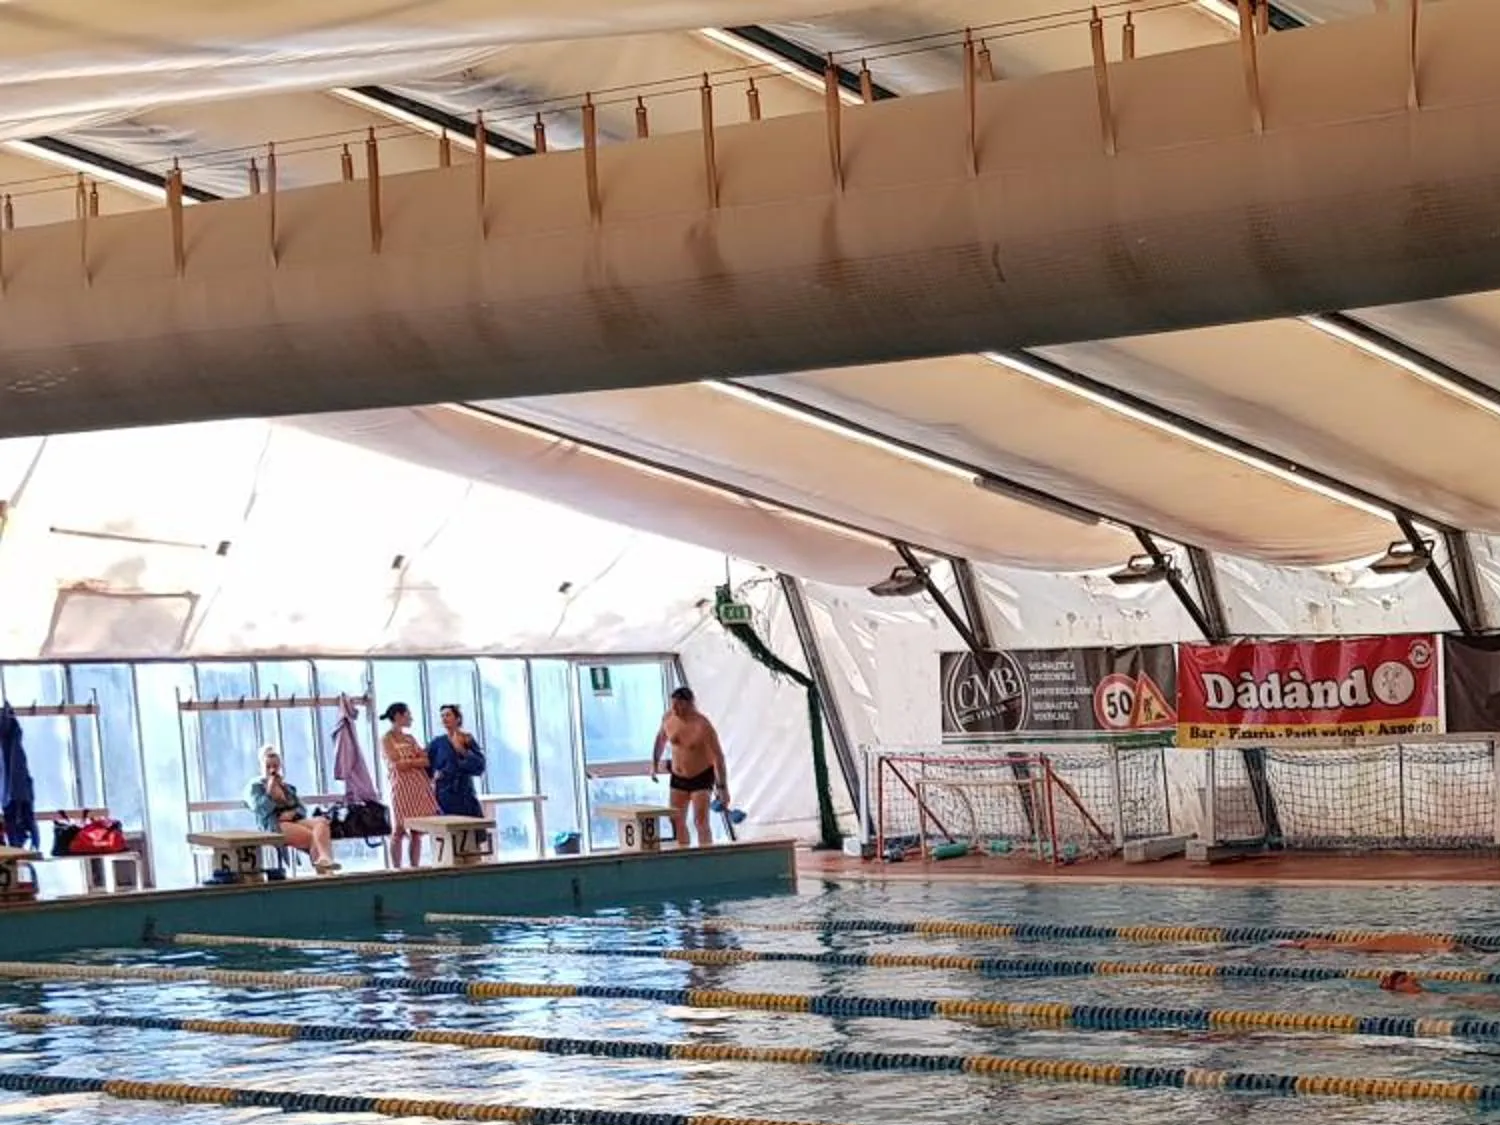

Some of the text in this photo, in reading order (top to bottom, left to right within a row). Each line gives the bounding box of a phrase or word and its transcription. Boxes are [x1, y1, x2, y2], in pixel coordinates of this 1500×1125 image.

[958, 666, 1018, 710] CMB
[1201, 668, 1372, 709] Dàdànd
[1106, 690, 1132, 719] 50
[1190, 726, 1217, 739] Bar
[435, 836, 445, 862] 7
[625, 824, 635, 847] 8
